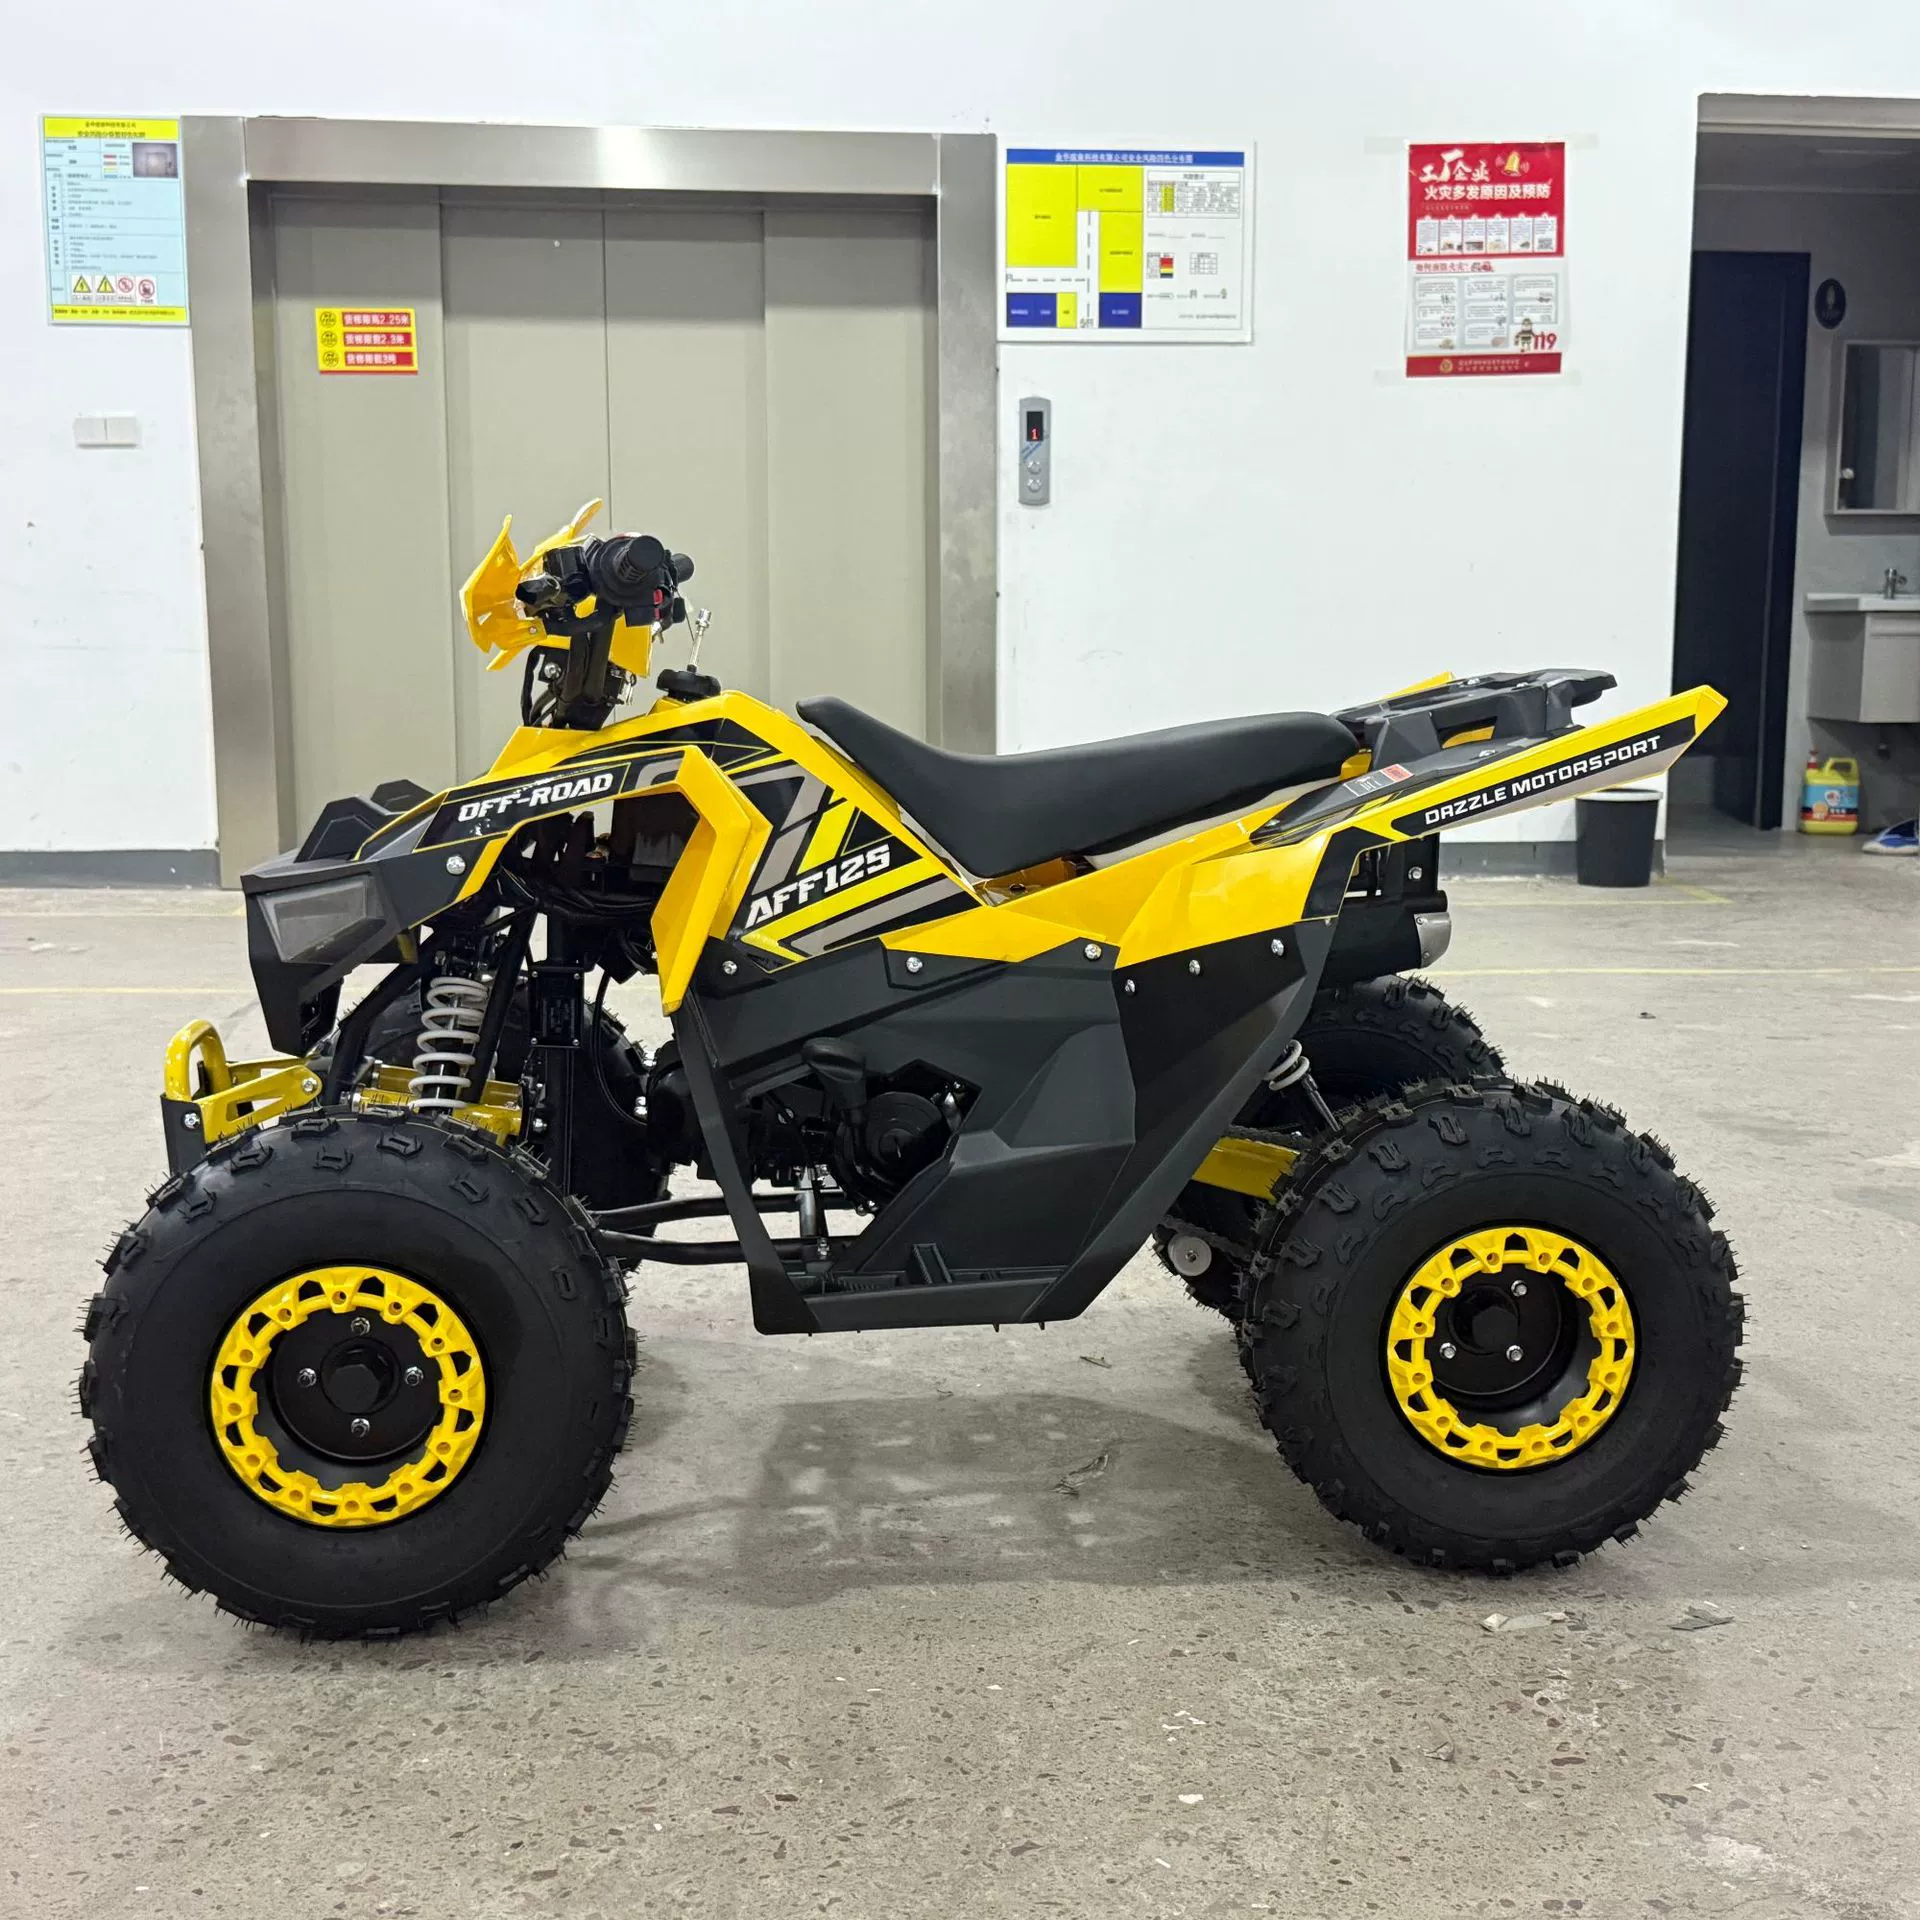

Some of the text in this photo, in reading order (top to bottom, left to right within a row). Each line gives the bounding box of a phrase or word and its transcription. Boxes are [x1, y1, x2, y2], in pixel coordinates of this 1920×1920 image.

[1419, 148, 1490, 183] 工厂企业
[1424, 183, 1552, 200] 火灾多发原因及预防
[1534, 331, 1557, 350] 119
[1031, 428, 1038, 440] 1
[458, 773, 614, 822] OFF-ROAD
[1425, 735, 1660, 825] DAZZLE MOTORSPORT
[745, 844, 890, 929] AFF125
